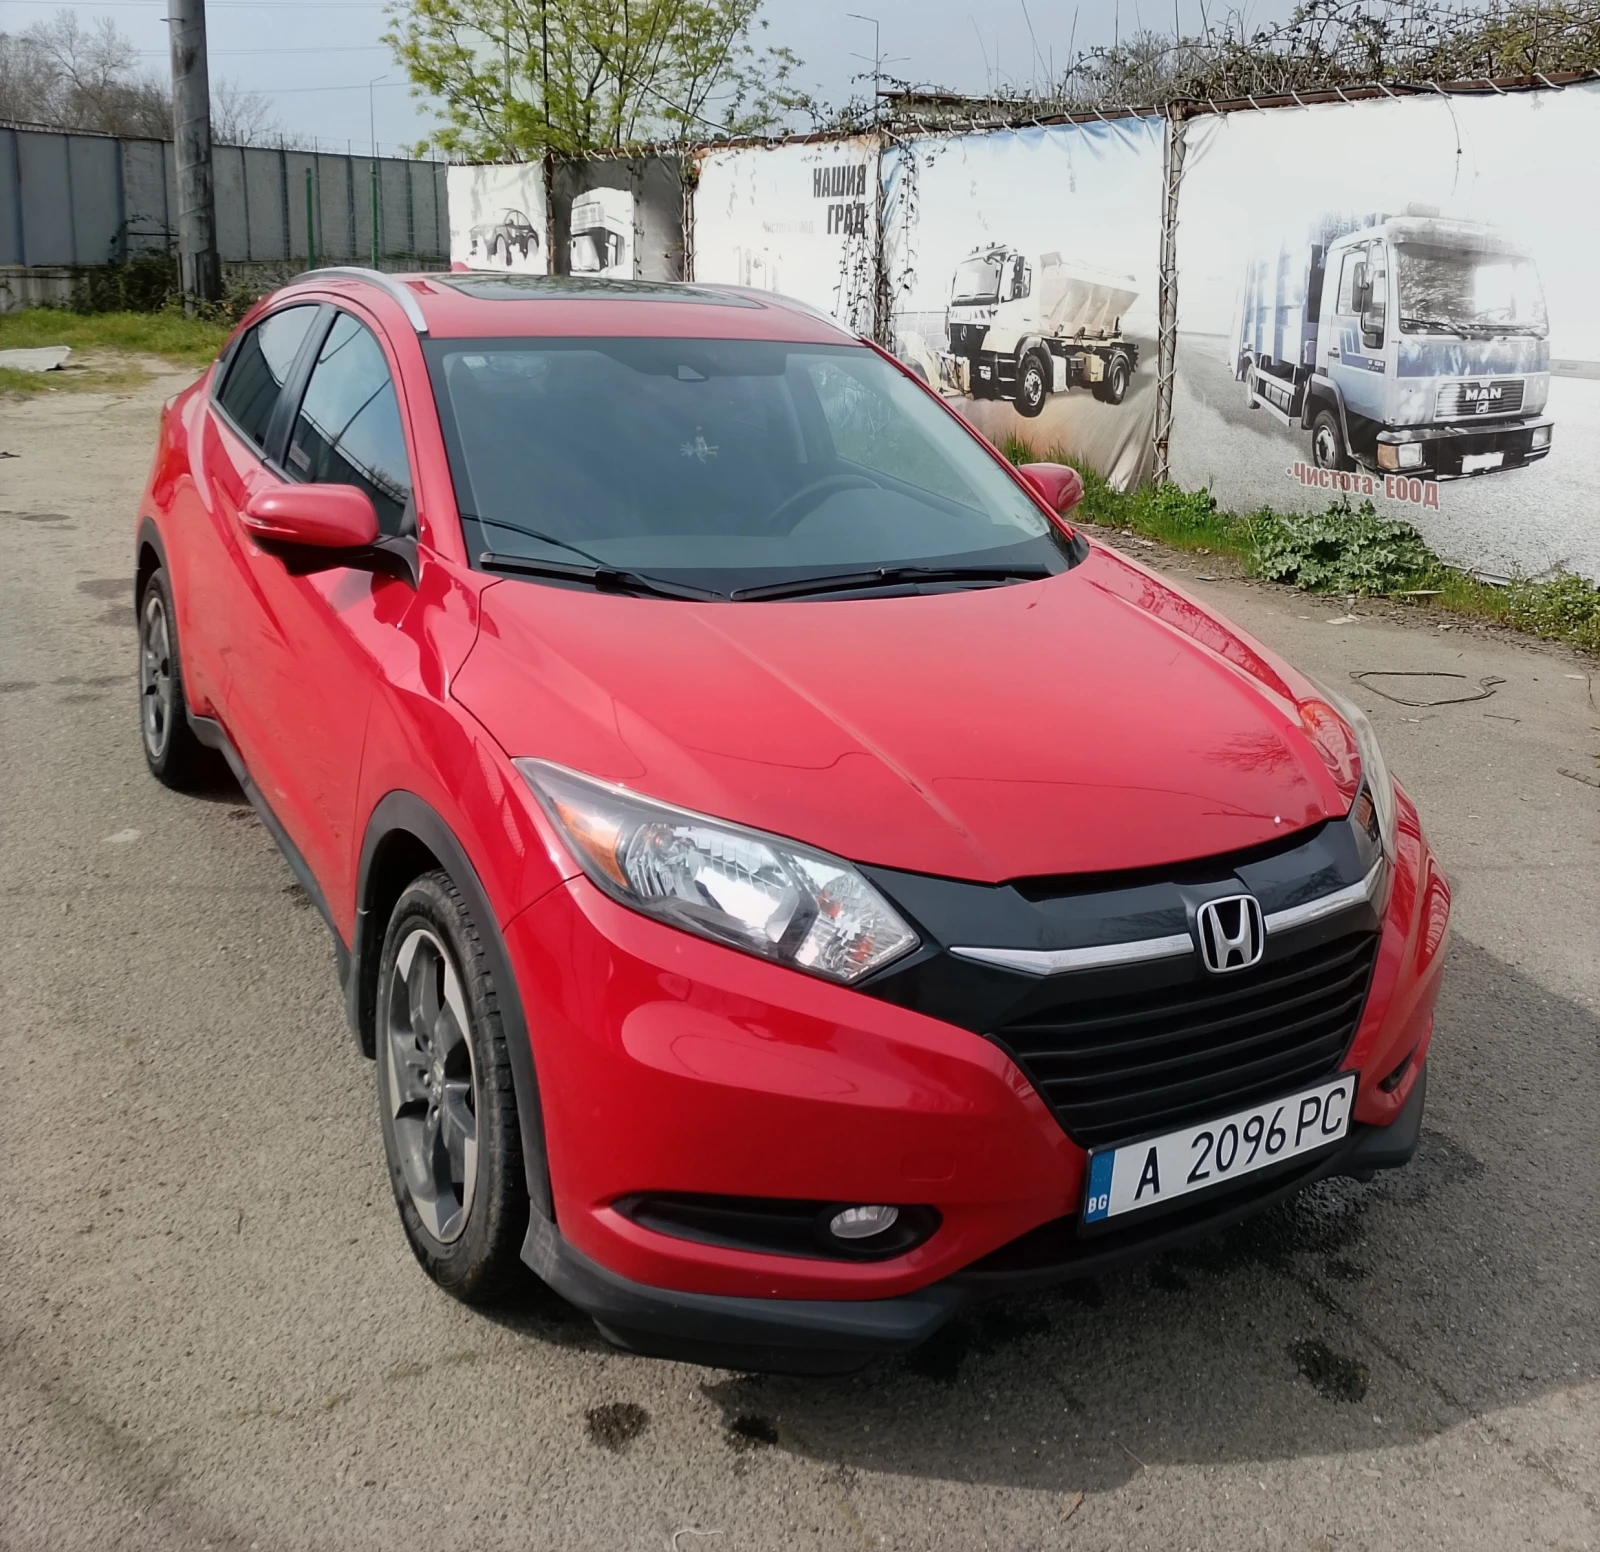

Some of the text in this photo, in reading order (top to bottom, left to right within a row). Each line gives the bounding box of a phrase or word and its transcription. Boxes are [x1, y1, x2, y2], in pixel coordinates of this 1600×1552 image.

[813, 164, 867, 198] НАШИЯ
[827, 203, 866, 239] ГРАД
[1465, 387, 1502, 401] MAN
[1385, 475, 1439, 511] ЕООД
[1134, 1146, 1161, 1201] A
[1186, 1106, 1287, 1185] 2096
[1087, 1193, 1108, 1214] BG
